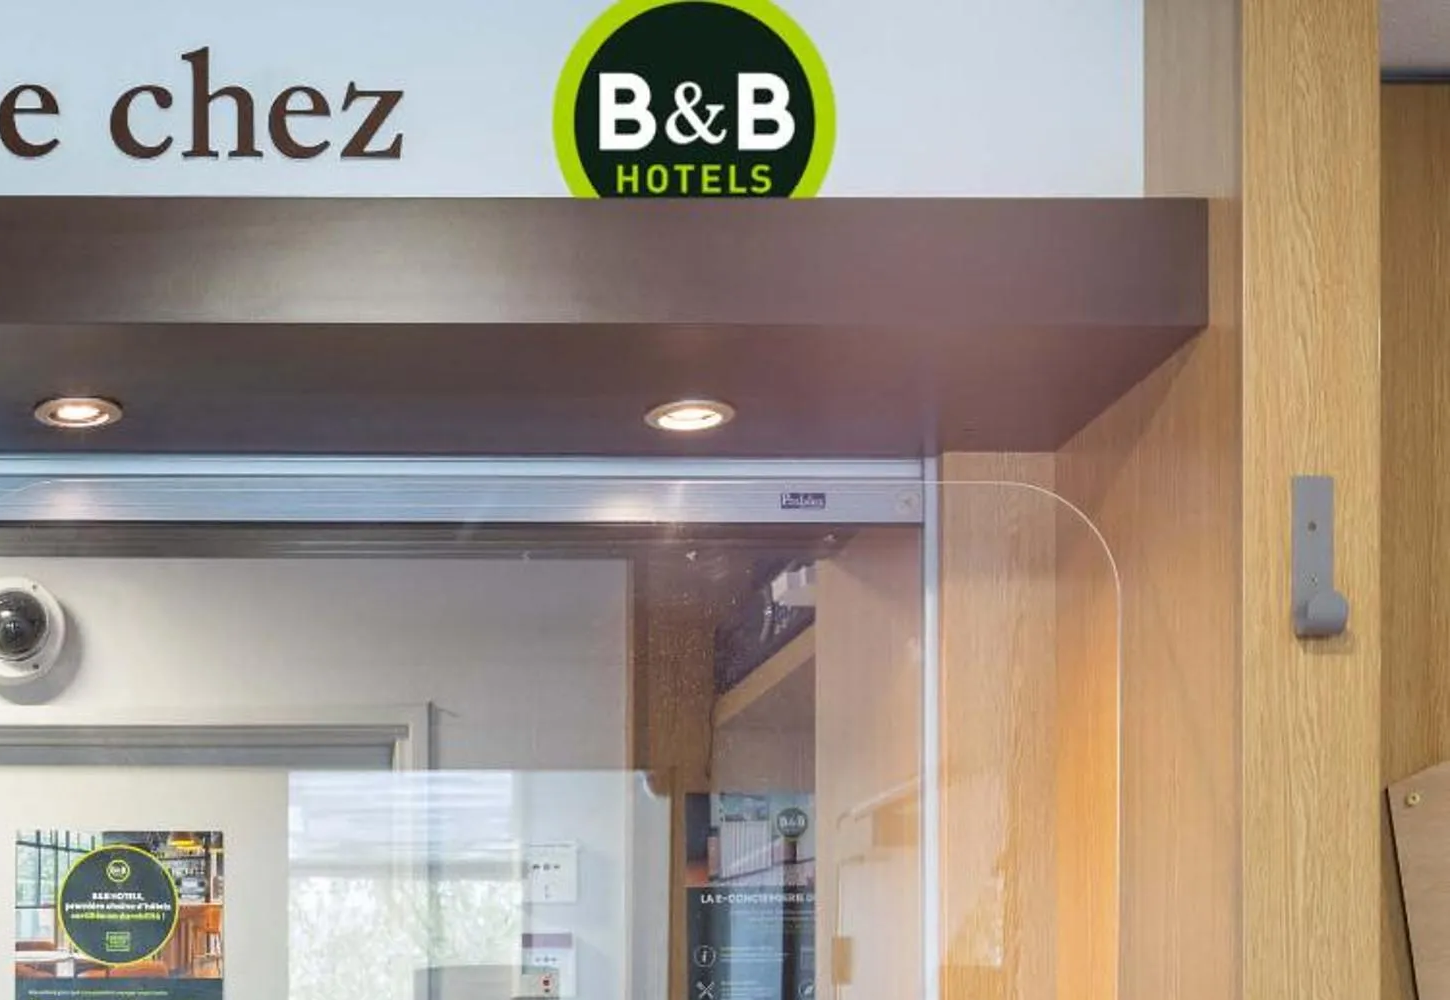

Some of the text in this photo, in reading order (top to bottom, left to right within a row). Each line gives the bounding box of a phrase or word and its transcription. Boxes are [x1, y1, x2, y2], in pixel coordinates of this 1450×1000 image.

[108, 46, 405, 160] chez
[598, 72, 796, 151] B&B
[616, 164, 773, 194] HOTELS
